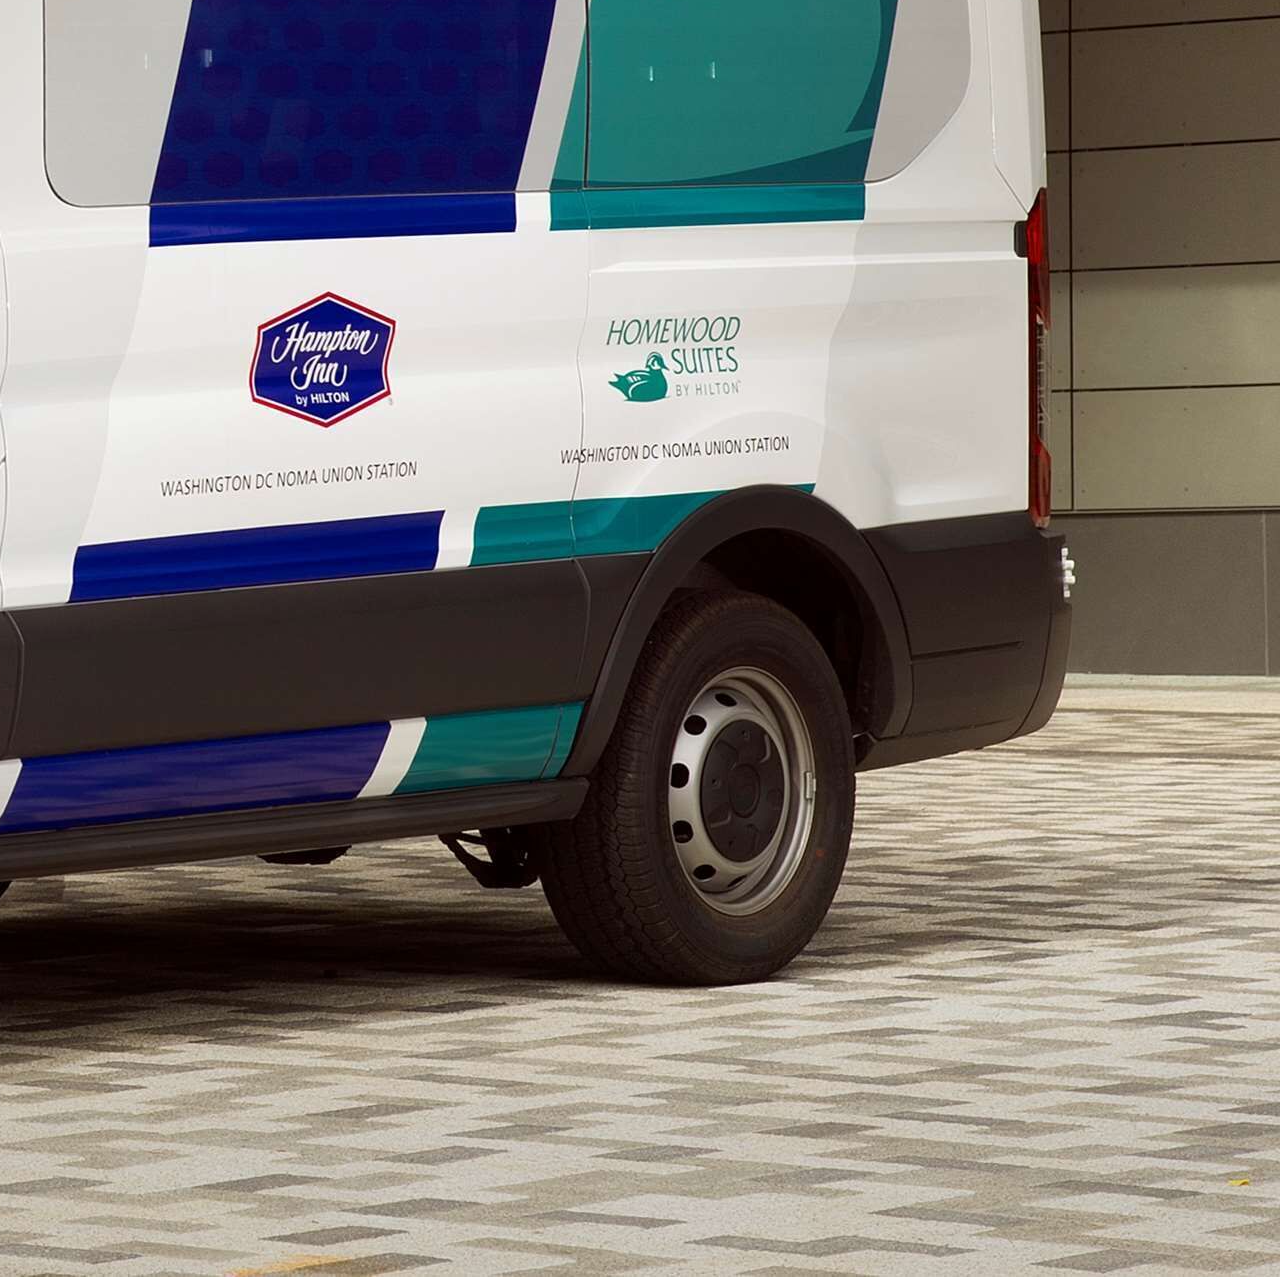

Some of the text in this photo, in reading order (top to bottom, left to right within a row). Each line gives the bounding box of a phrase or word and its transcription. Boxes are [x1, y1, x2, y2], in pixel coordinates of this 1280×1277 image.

[270, 320, 379, 364] Hampton
[606, 316, 741, 346] HOMEWOOD
[290, 354, 348, 391] Inn
[670, 346, 739, 375] SUITES
[295, 391, 350, 408] by HILTON
[675, 381, 739, 398] BY HILTON
[560, 435, 790, 465] WASHINGTON DC NOMA UNION STATION
[160, 460, 418, 497] WASHINGTON DC NOMA UNION STATION
